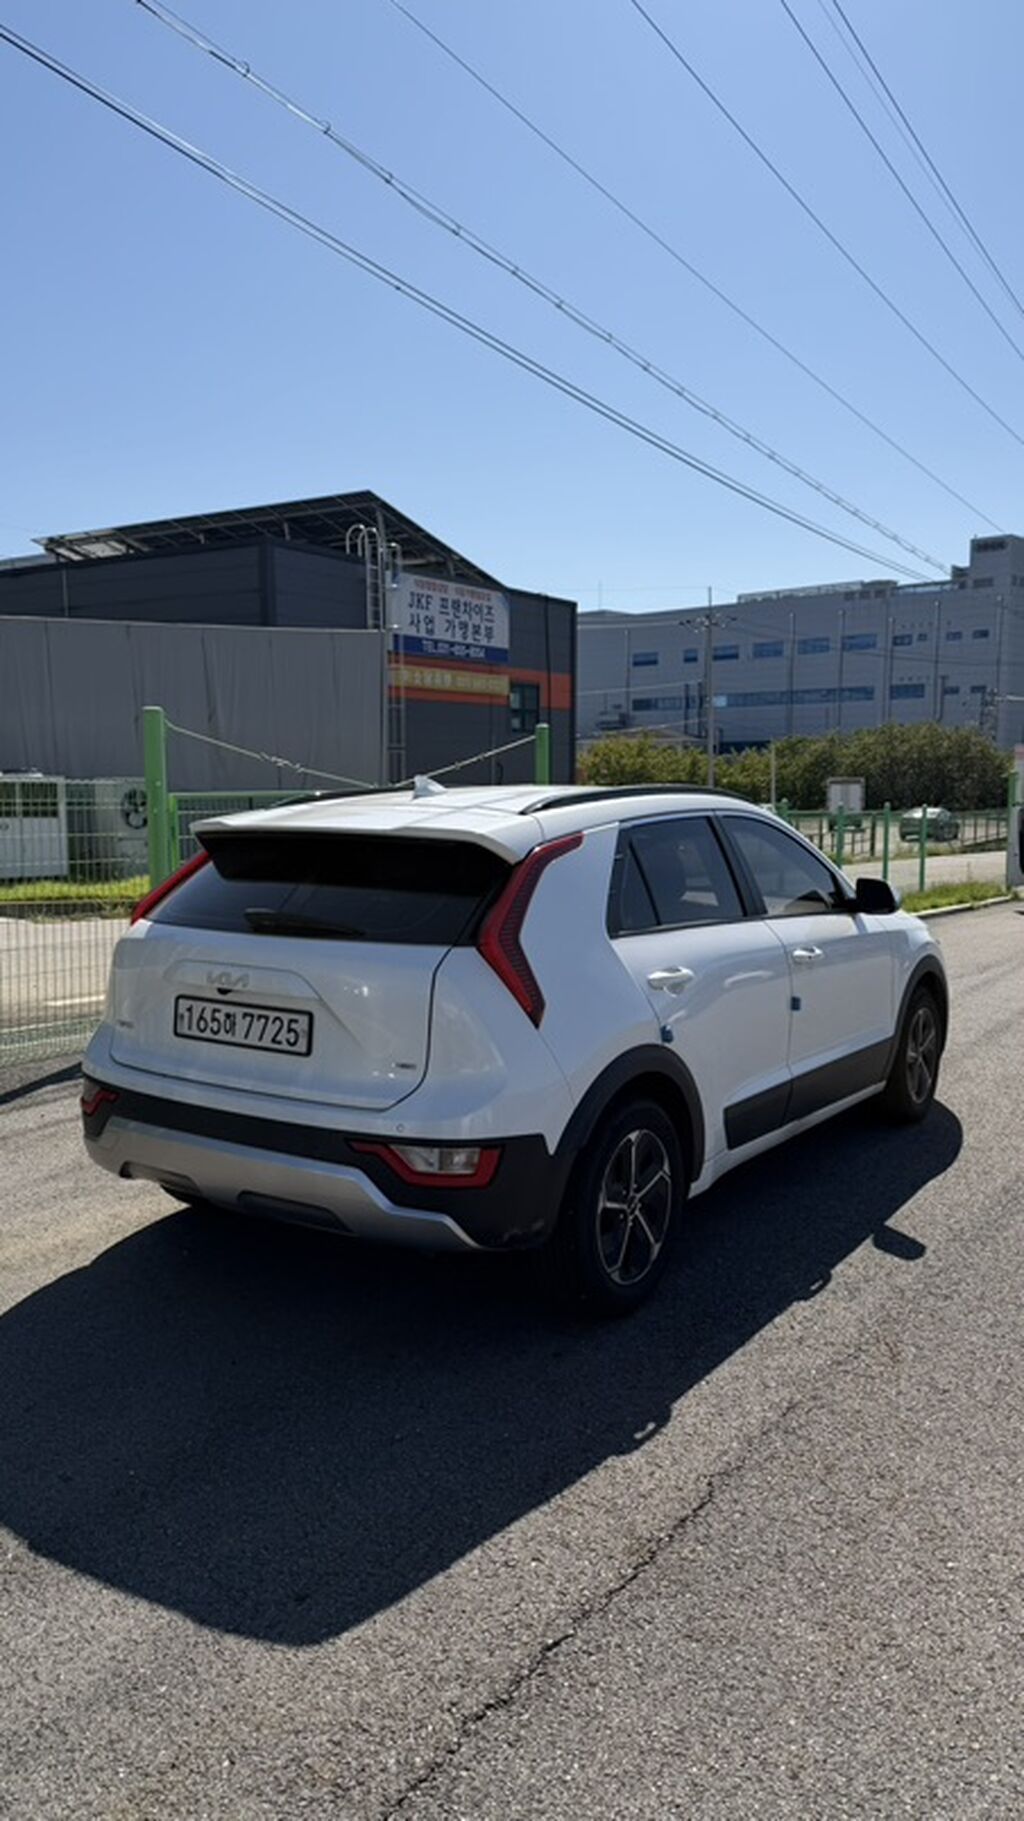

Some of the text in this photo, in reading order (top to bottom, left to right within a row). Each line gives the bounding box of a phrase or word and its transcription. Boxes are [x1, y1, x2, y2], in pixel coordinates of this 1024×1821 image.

[408, 591, 495, 623] JKF 프랜차이즈
[408, 613, 495, 643] 사업 가맹본부
[241, 1012, 300, 1047] 7725
